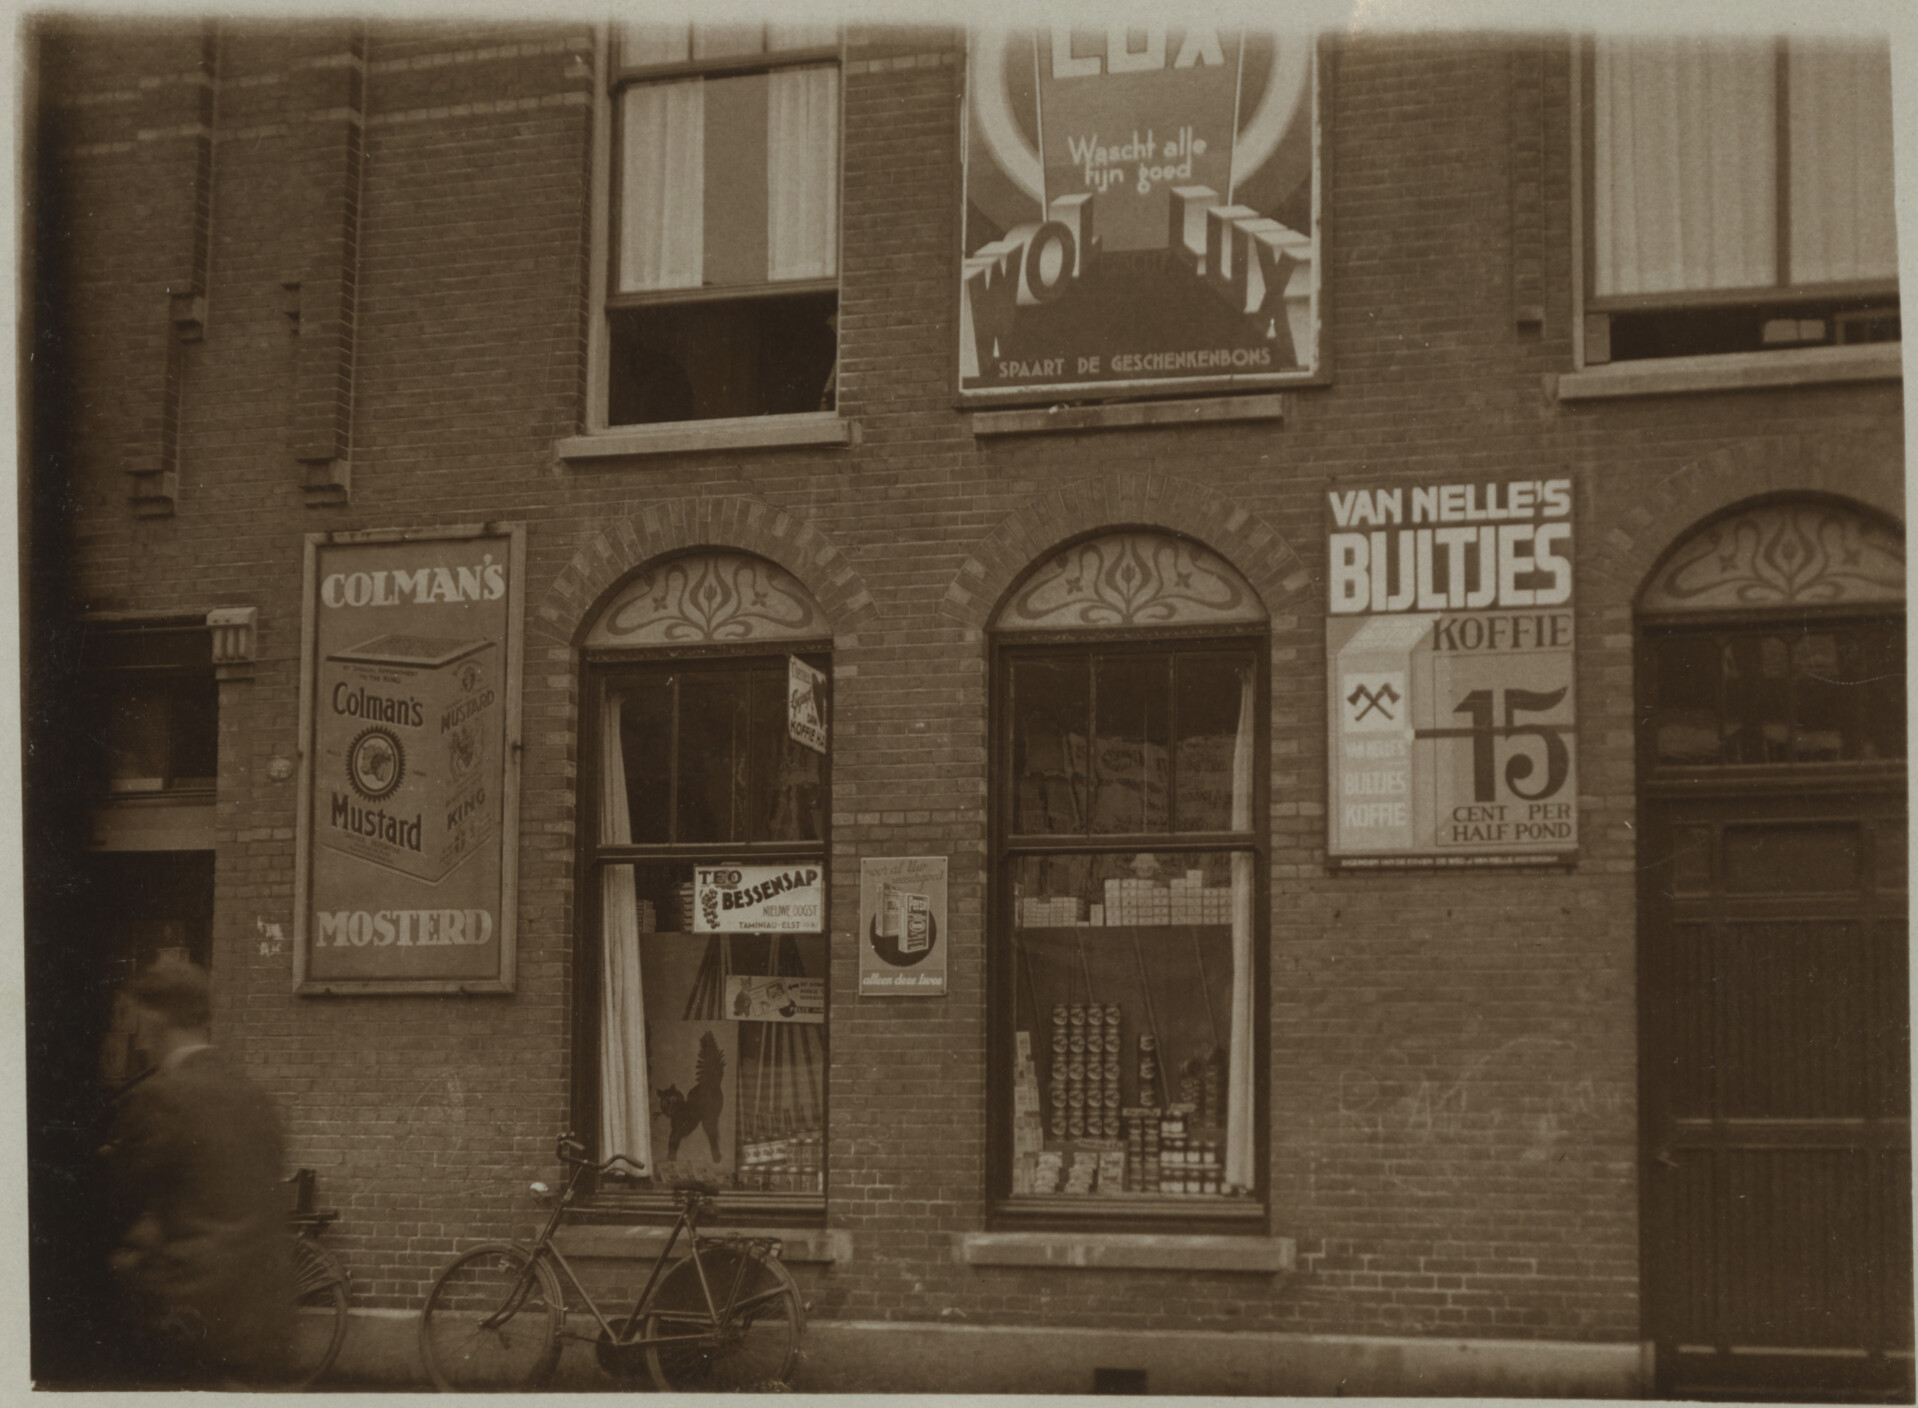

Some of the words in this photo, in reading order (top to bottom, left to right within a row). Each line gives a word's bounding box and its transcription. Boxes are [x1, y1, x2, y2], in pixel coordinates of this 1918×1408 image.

[1068, 129, 1156, 166] Wascht
[1164, 126, 1207, 159] alle
[1086, 163, 1124, 192] fijn
[1139, 160, 1192, 193] goed
[999, 357, 1065, 378] SPAART
[1077, 355, 1101, 375] DE
[1111, 348, 1271, 371] GESCHENKENBONS
[1329, 488, 1402, 527] VAN
[1412, 479, 1571, 524] NELLE'S
[320, 553, 506, 609] COLMAN'S
[1330, 522, 1572, 614] BIJLTJES
[1432, 615, 1573, 651] KOFFIE
[332, 681, 424, 728] Colman's
[441, 690, 495, 735] MUSTARD
[1452, 686, 1569, 802] 15
[1344, 771, 1406, 795] BIJLTJES
[331, 792, 423, 853] Mustard
[446, 788, 487, 833] KING
[1345, 803, 1408, 828] KOFFIE
[1452, 804, 1508, 822] CENT
[1528, 803, 1571, 820] PER
[1452, 823, 1506, 841] HALF
[1514, 822, 1571, 839] POND
[722, 869, 818, 910] BESSENSAP
[316, 908, 493, 949] MOSTERD
[762, 905, 790, 918] NIEUWE
[791, 905, 817, 918] OOGST
